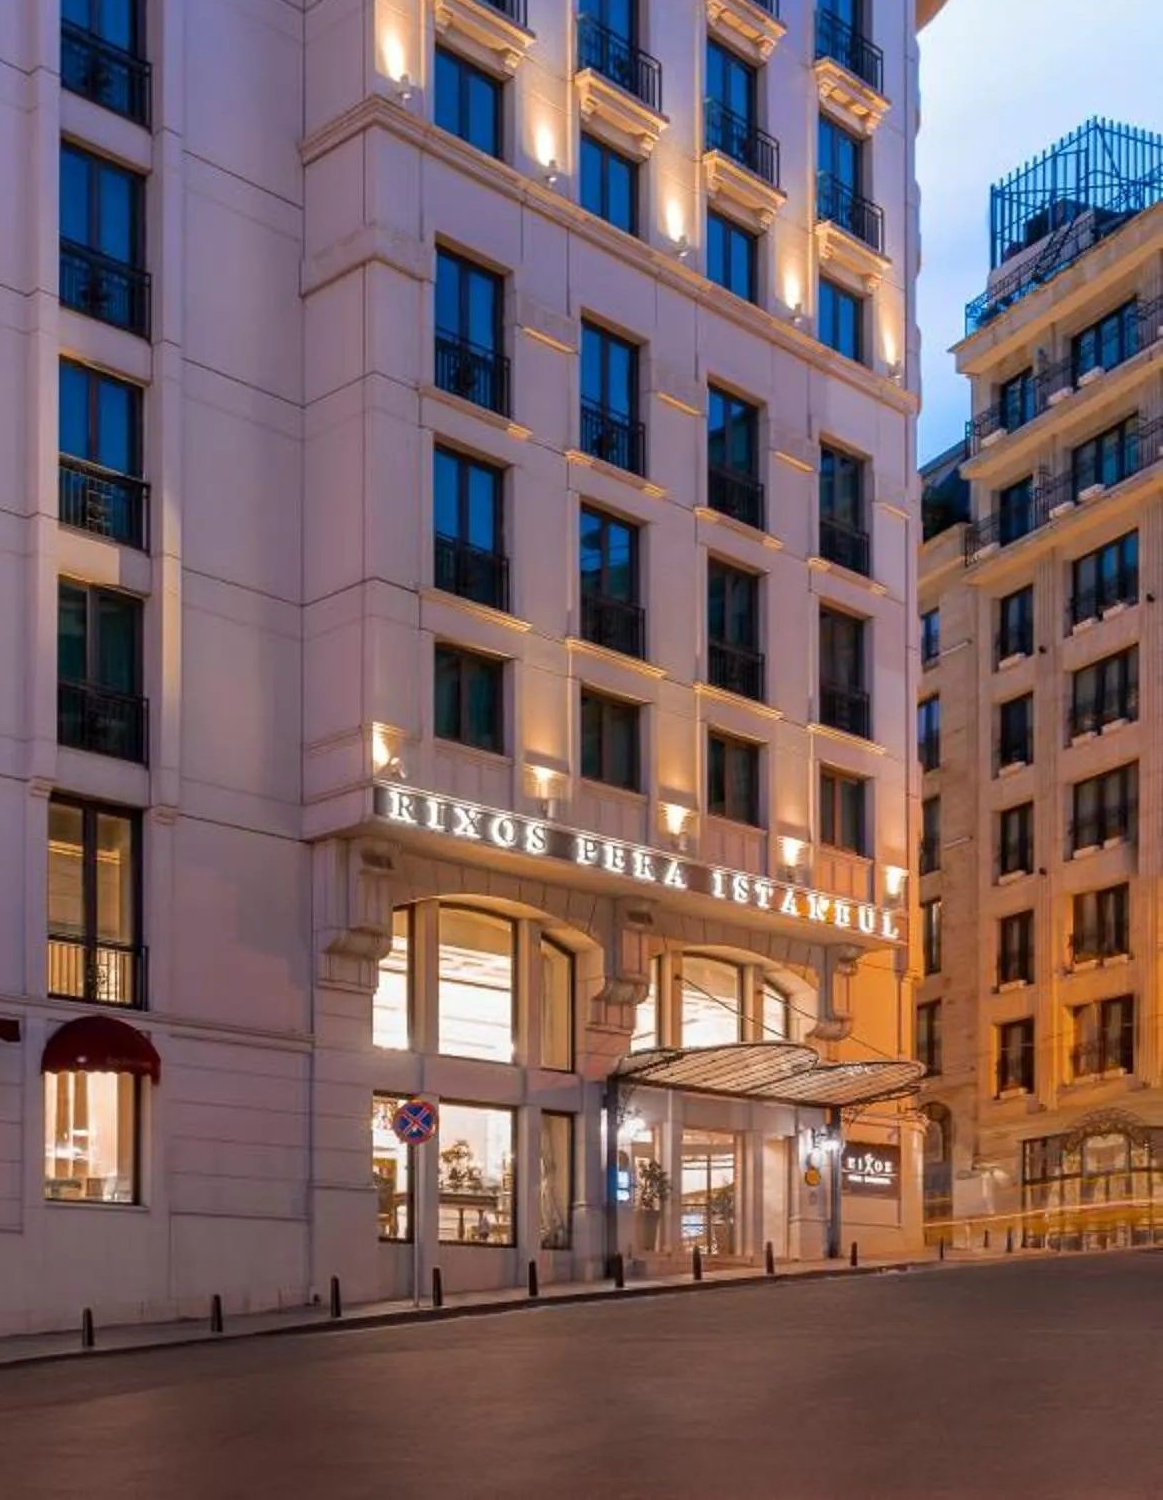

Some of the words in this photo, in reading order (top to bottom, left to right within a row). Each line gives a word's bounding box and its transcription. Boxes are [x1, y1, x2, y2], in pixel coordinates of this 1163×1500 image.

[388, 791, 548, 854] RIXOS
[575, 835, 687, 889] PERA
[711, 868, 899, 940] ISTANBUL
